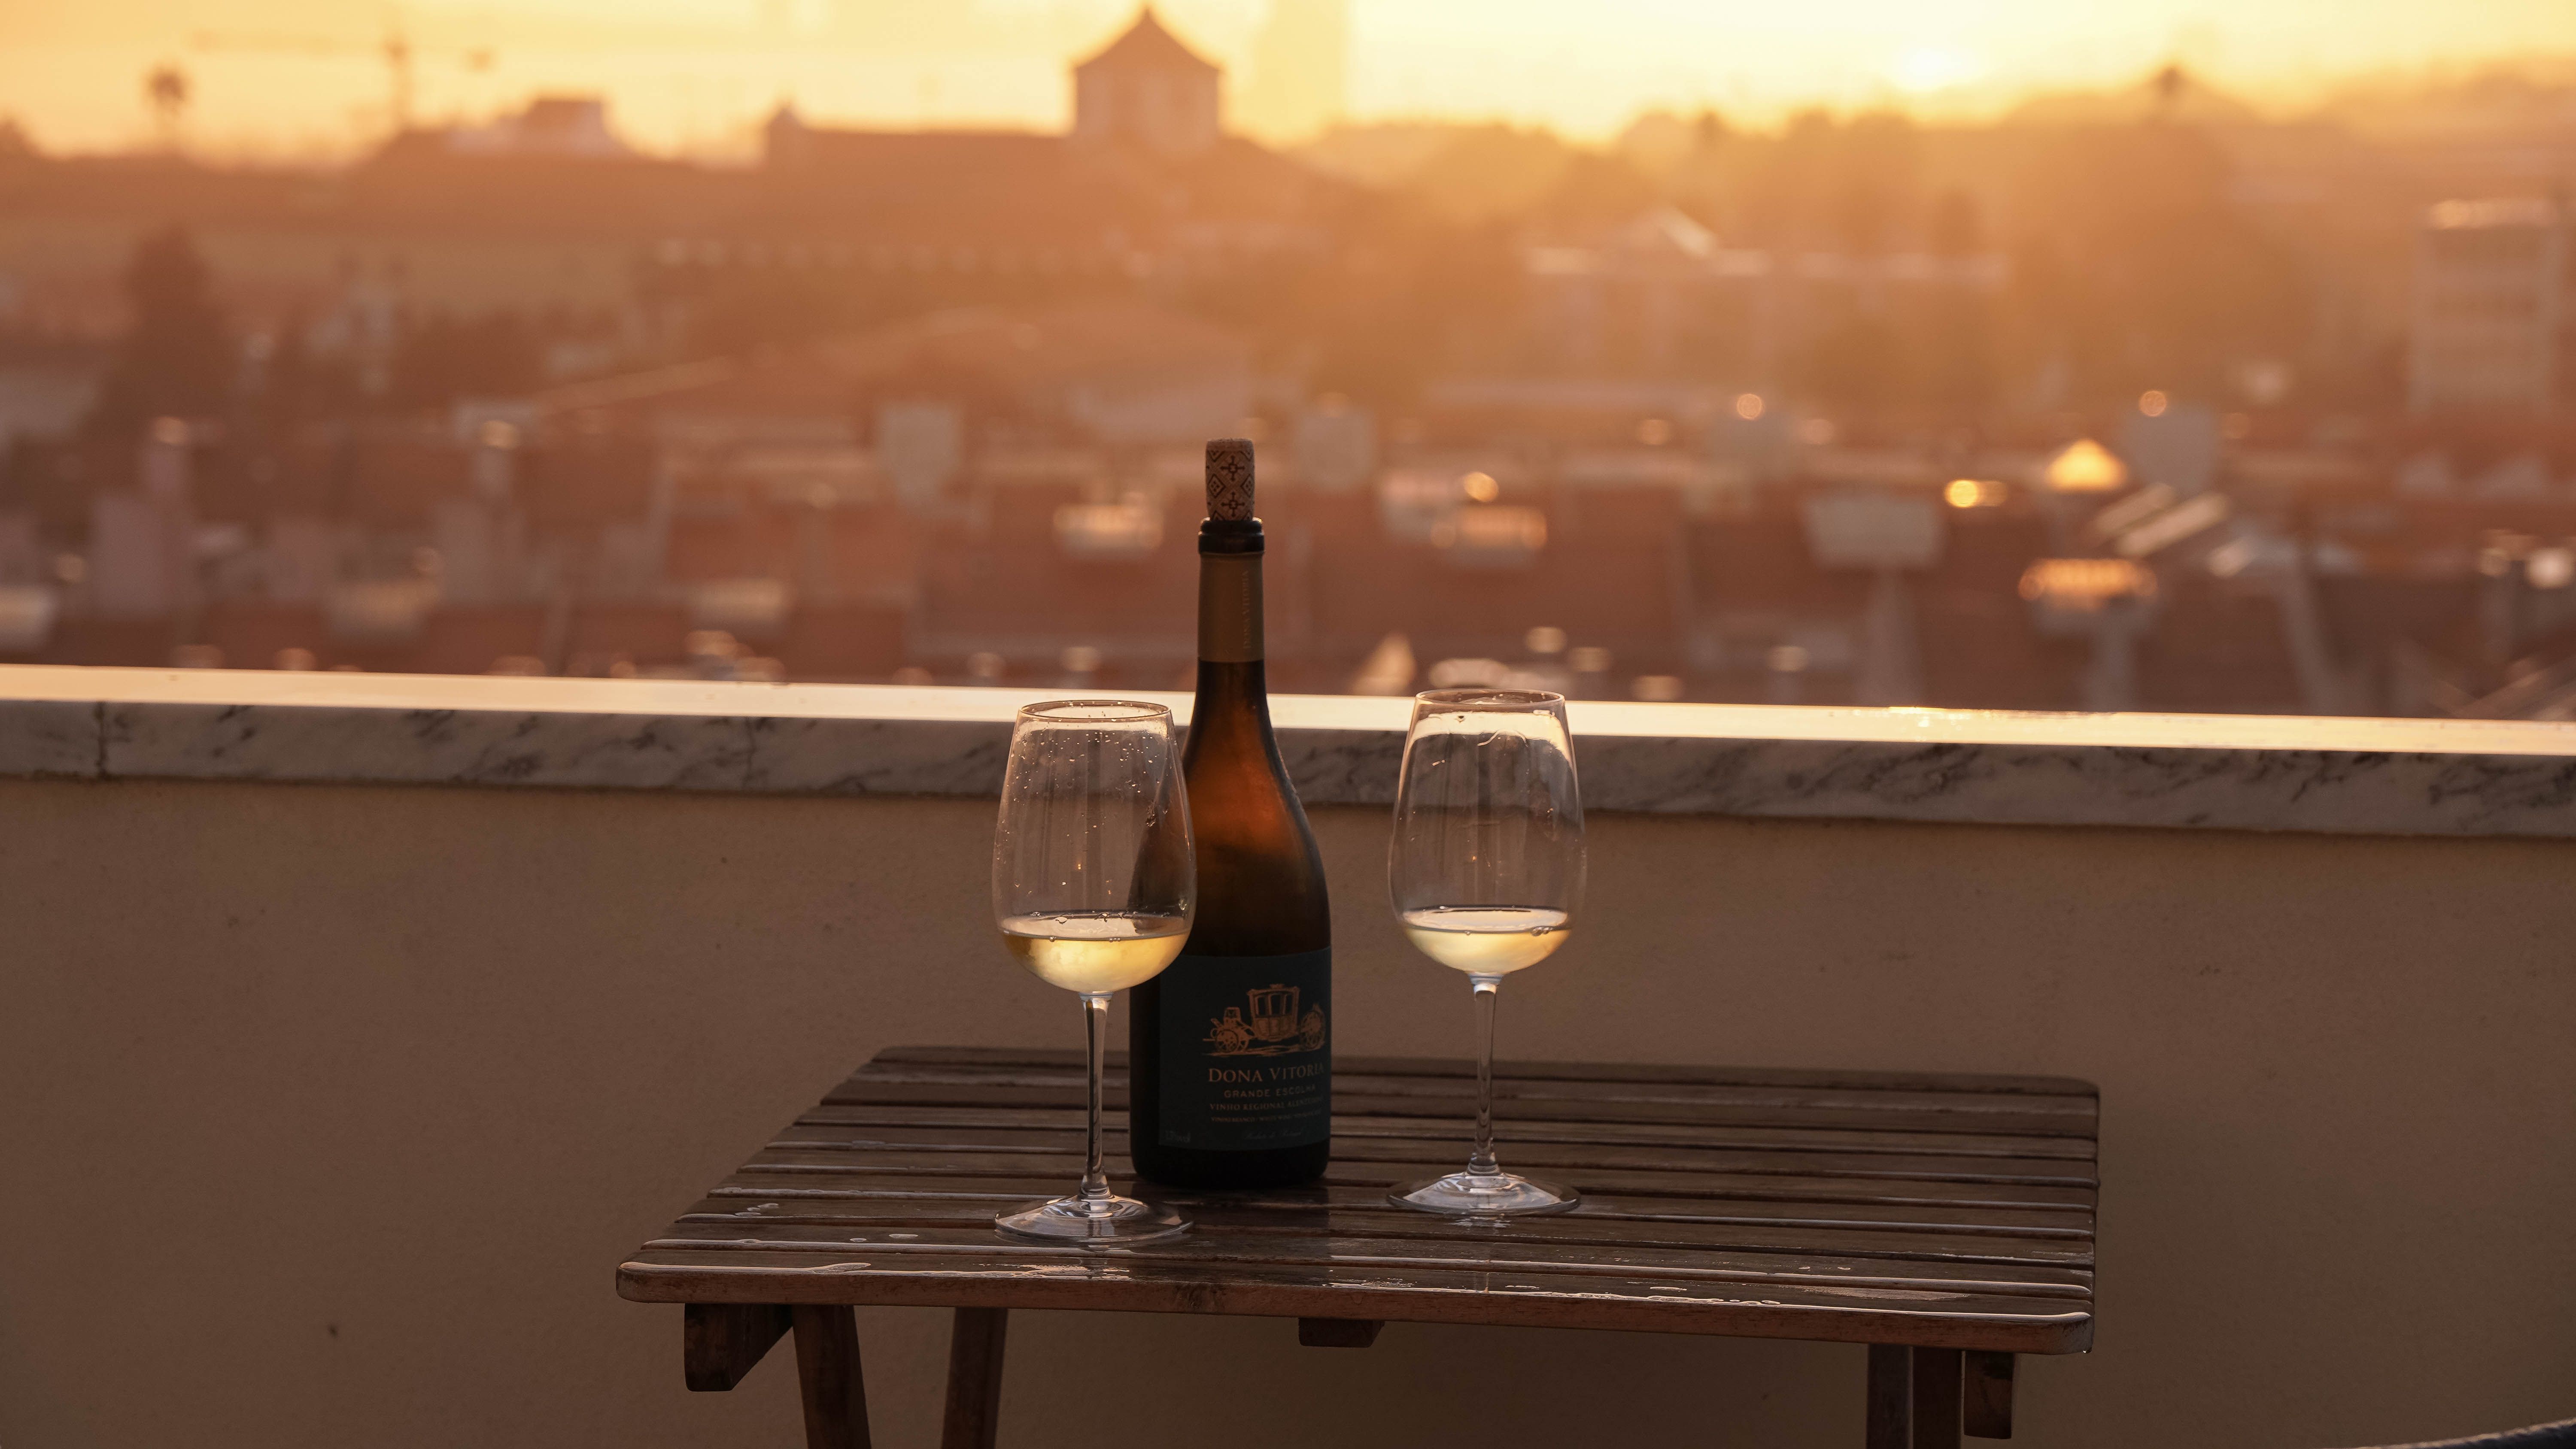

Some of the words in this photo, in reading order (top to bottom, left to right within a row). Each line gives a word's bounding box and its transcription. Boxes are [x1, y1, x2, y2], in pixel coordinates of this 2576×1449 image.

[1208, 1067, 1263, 1082] DONA
[1270, 1062, 1324, 1080] VITORIA
[1224, 1088, 1271, 1098] GRANDE
[1275, 1084, 1316, 1096] ESCOLHA
[1209, 1103, 1240, 1111] VINHO
[1243, 1101, 1285, 1111] REGIONAL
